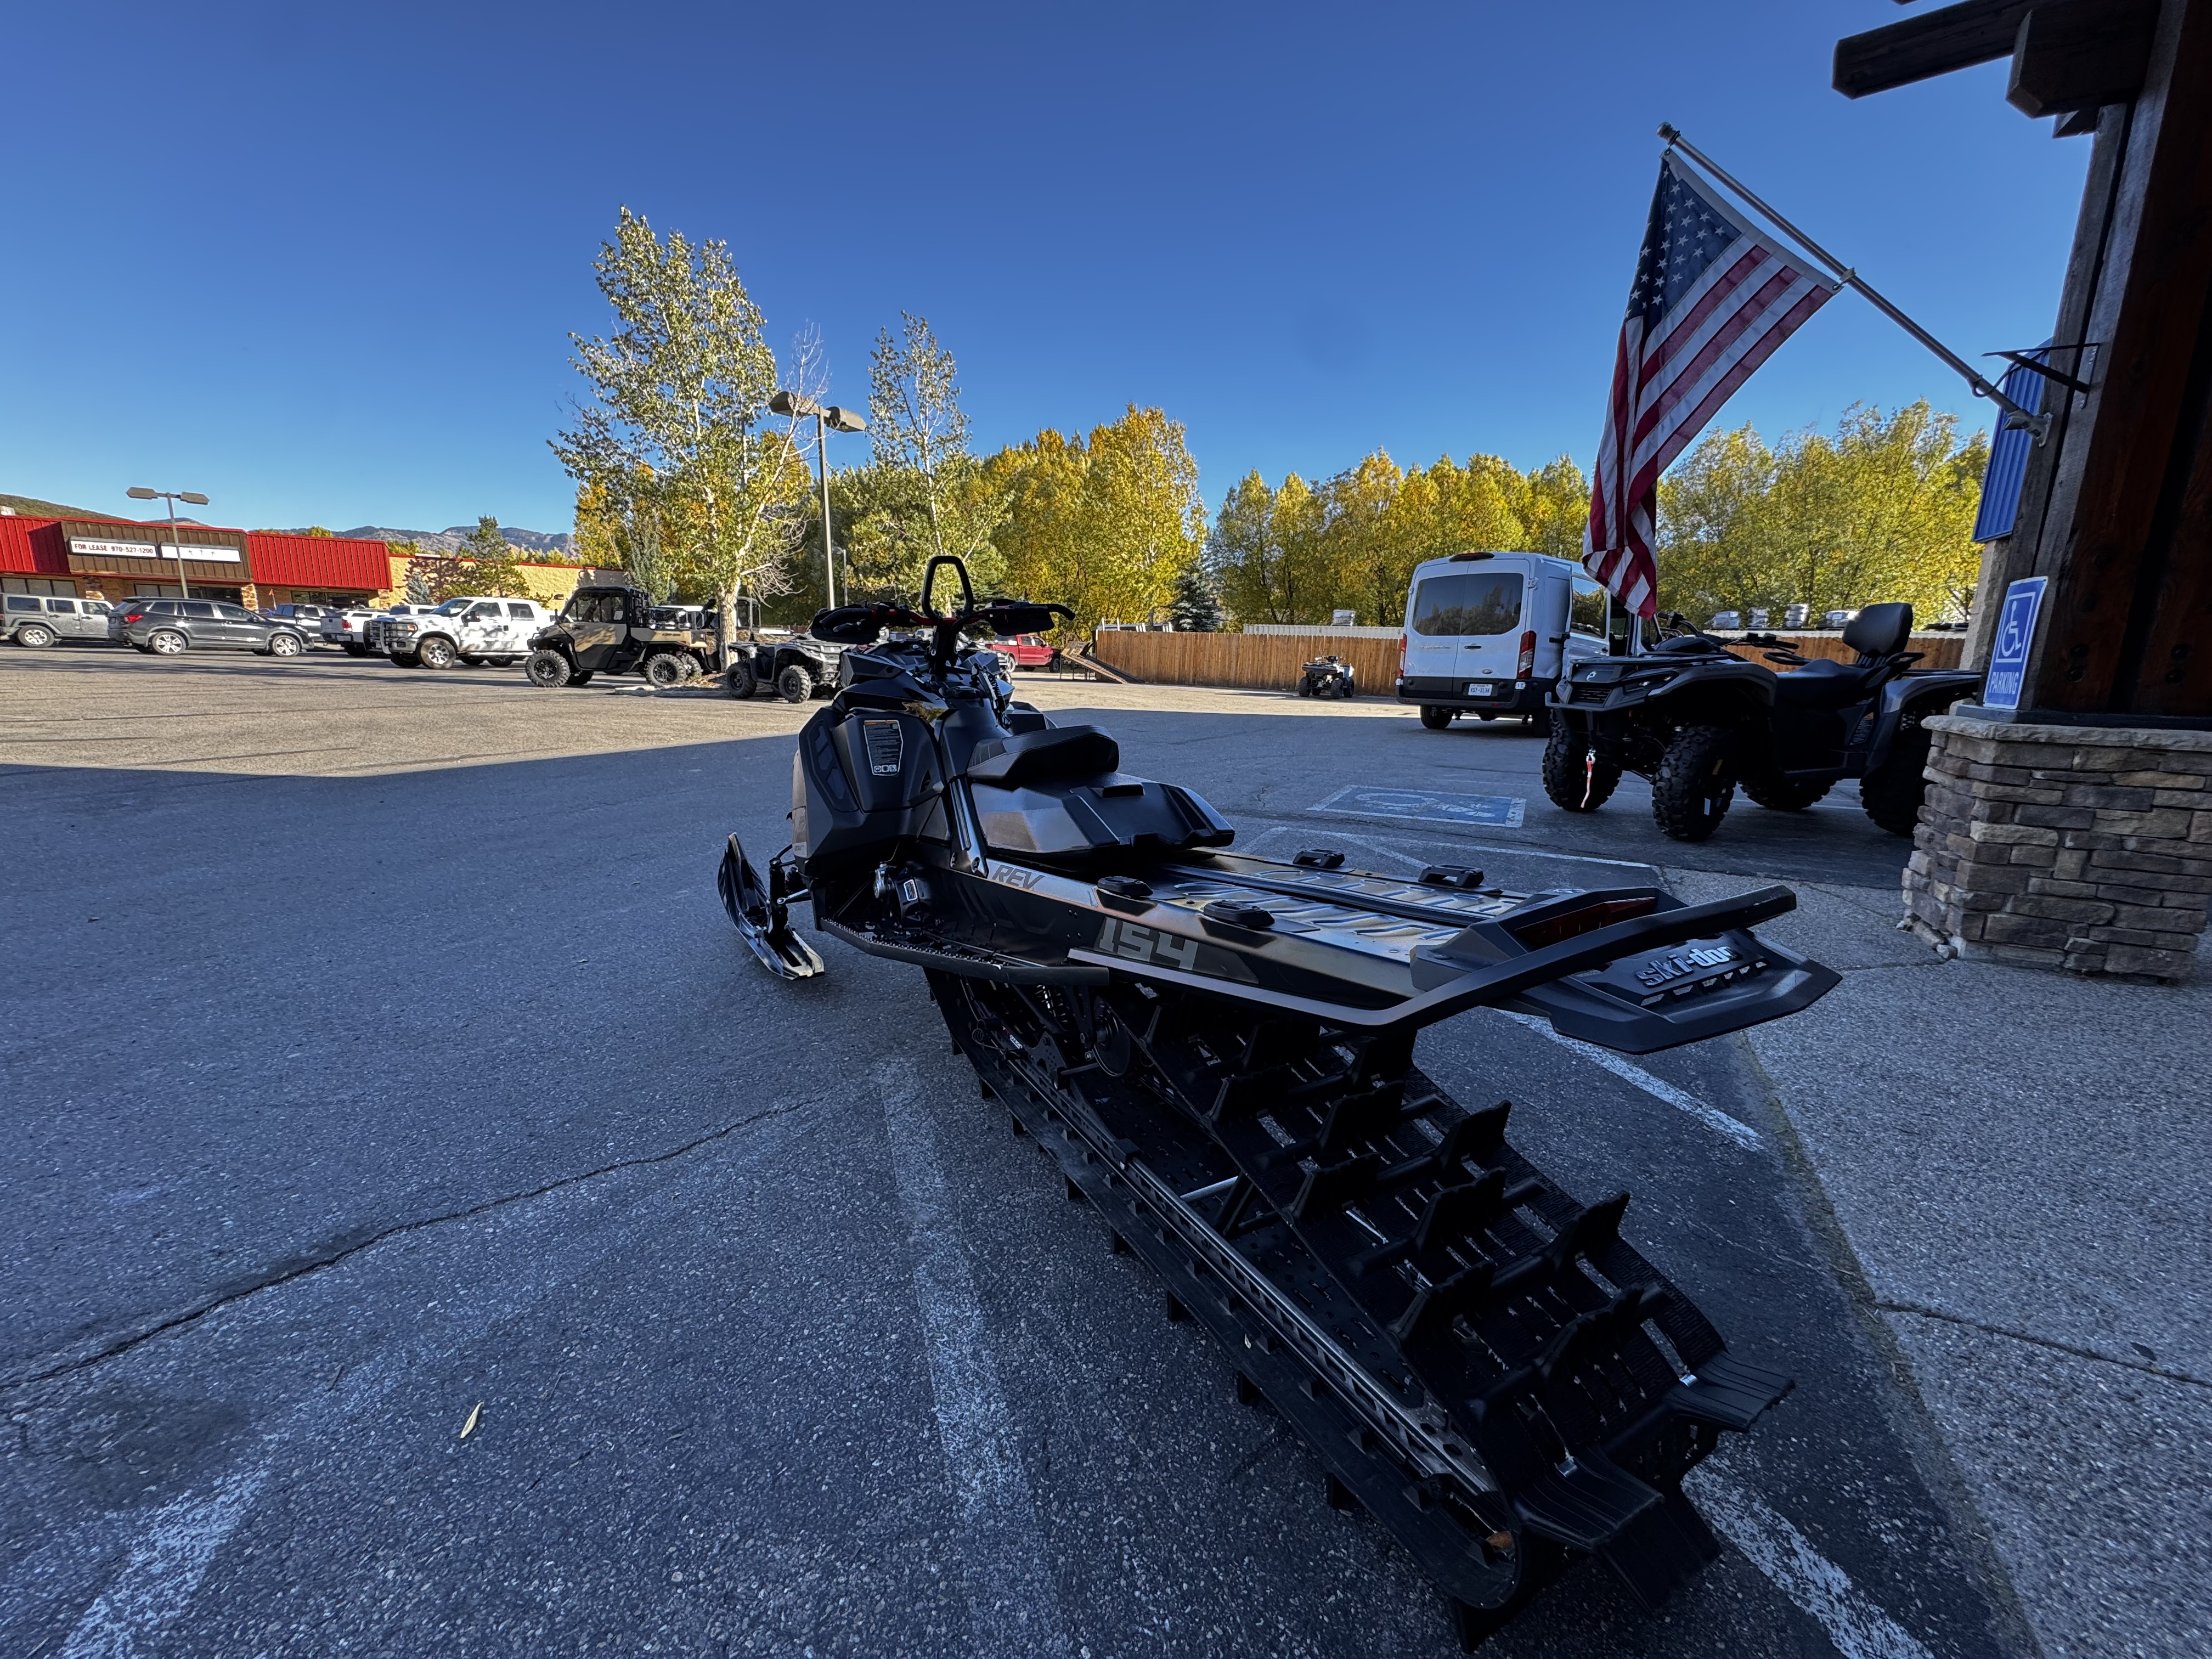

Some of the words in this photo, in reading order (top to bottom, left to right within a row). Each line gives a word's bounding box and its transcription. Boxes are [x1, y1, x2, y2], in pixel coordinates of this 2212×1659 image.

[1989, 672, 2019, 695] PARKING
[991, 864, 1045, 890] REV
[1099, 916, 1199, 970] 154
